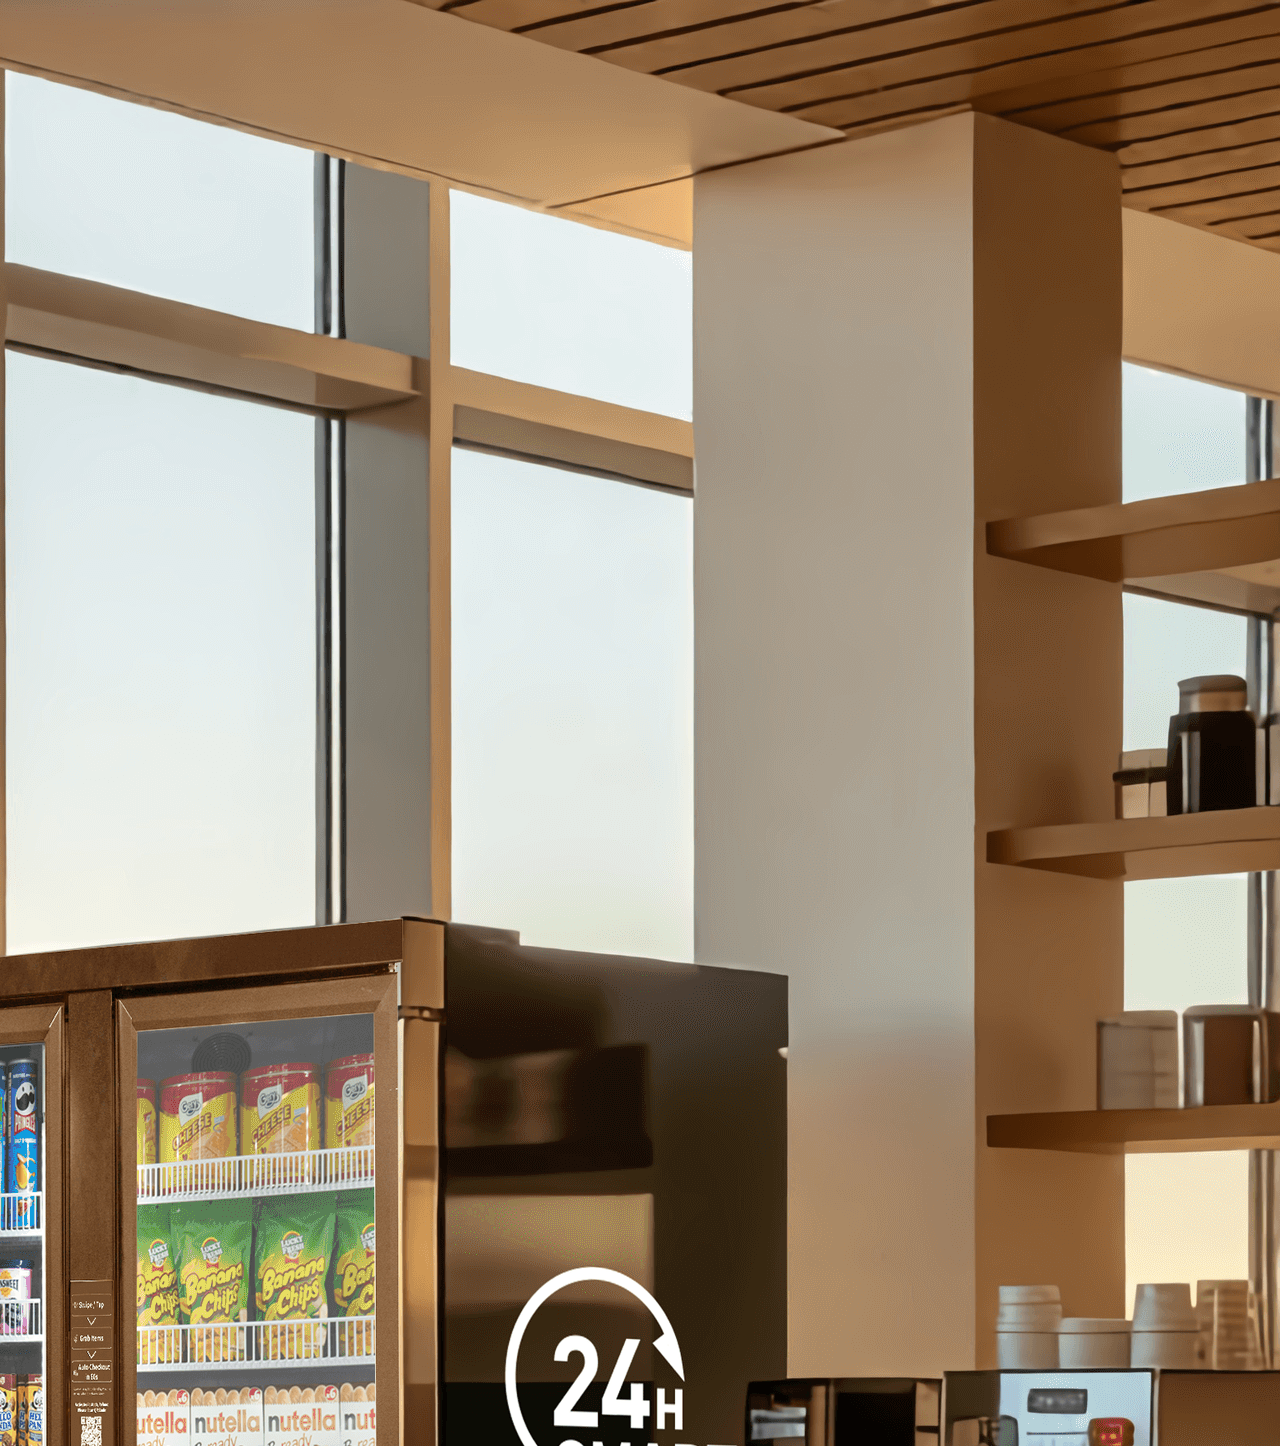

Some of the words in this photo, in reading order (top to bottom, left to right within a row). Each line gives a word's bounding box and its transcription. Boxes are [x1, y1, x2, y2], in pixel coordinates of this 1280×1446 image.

[186, 1261, 244, 1308] Banana
[262, 1255, 326, 1305] Banana
[276, 1278, 319, 1317] Chips
[201, 1283, 240, 1320] Chips
[553, 1334, 684, 1431] 24H
[195, 1409, 260, 1434] nutella
[268, 1407, 336, 1432] nutella
